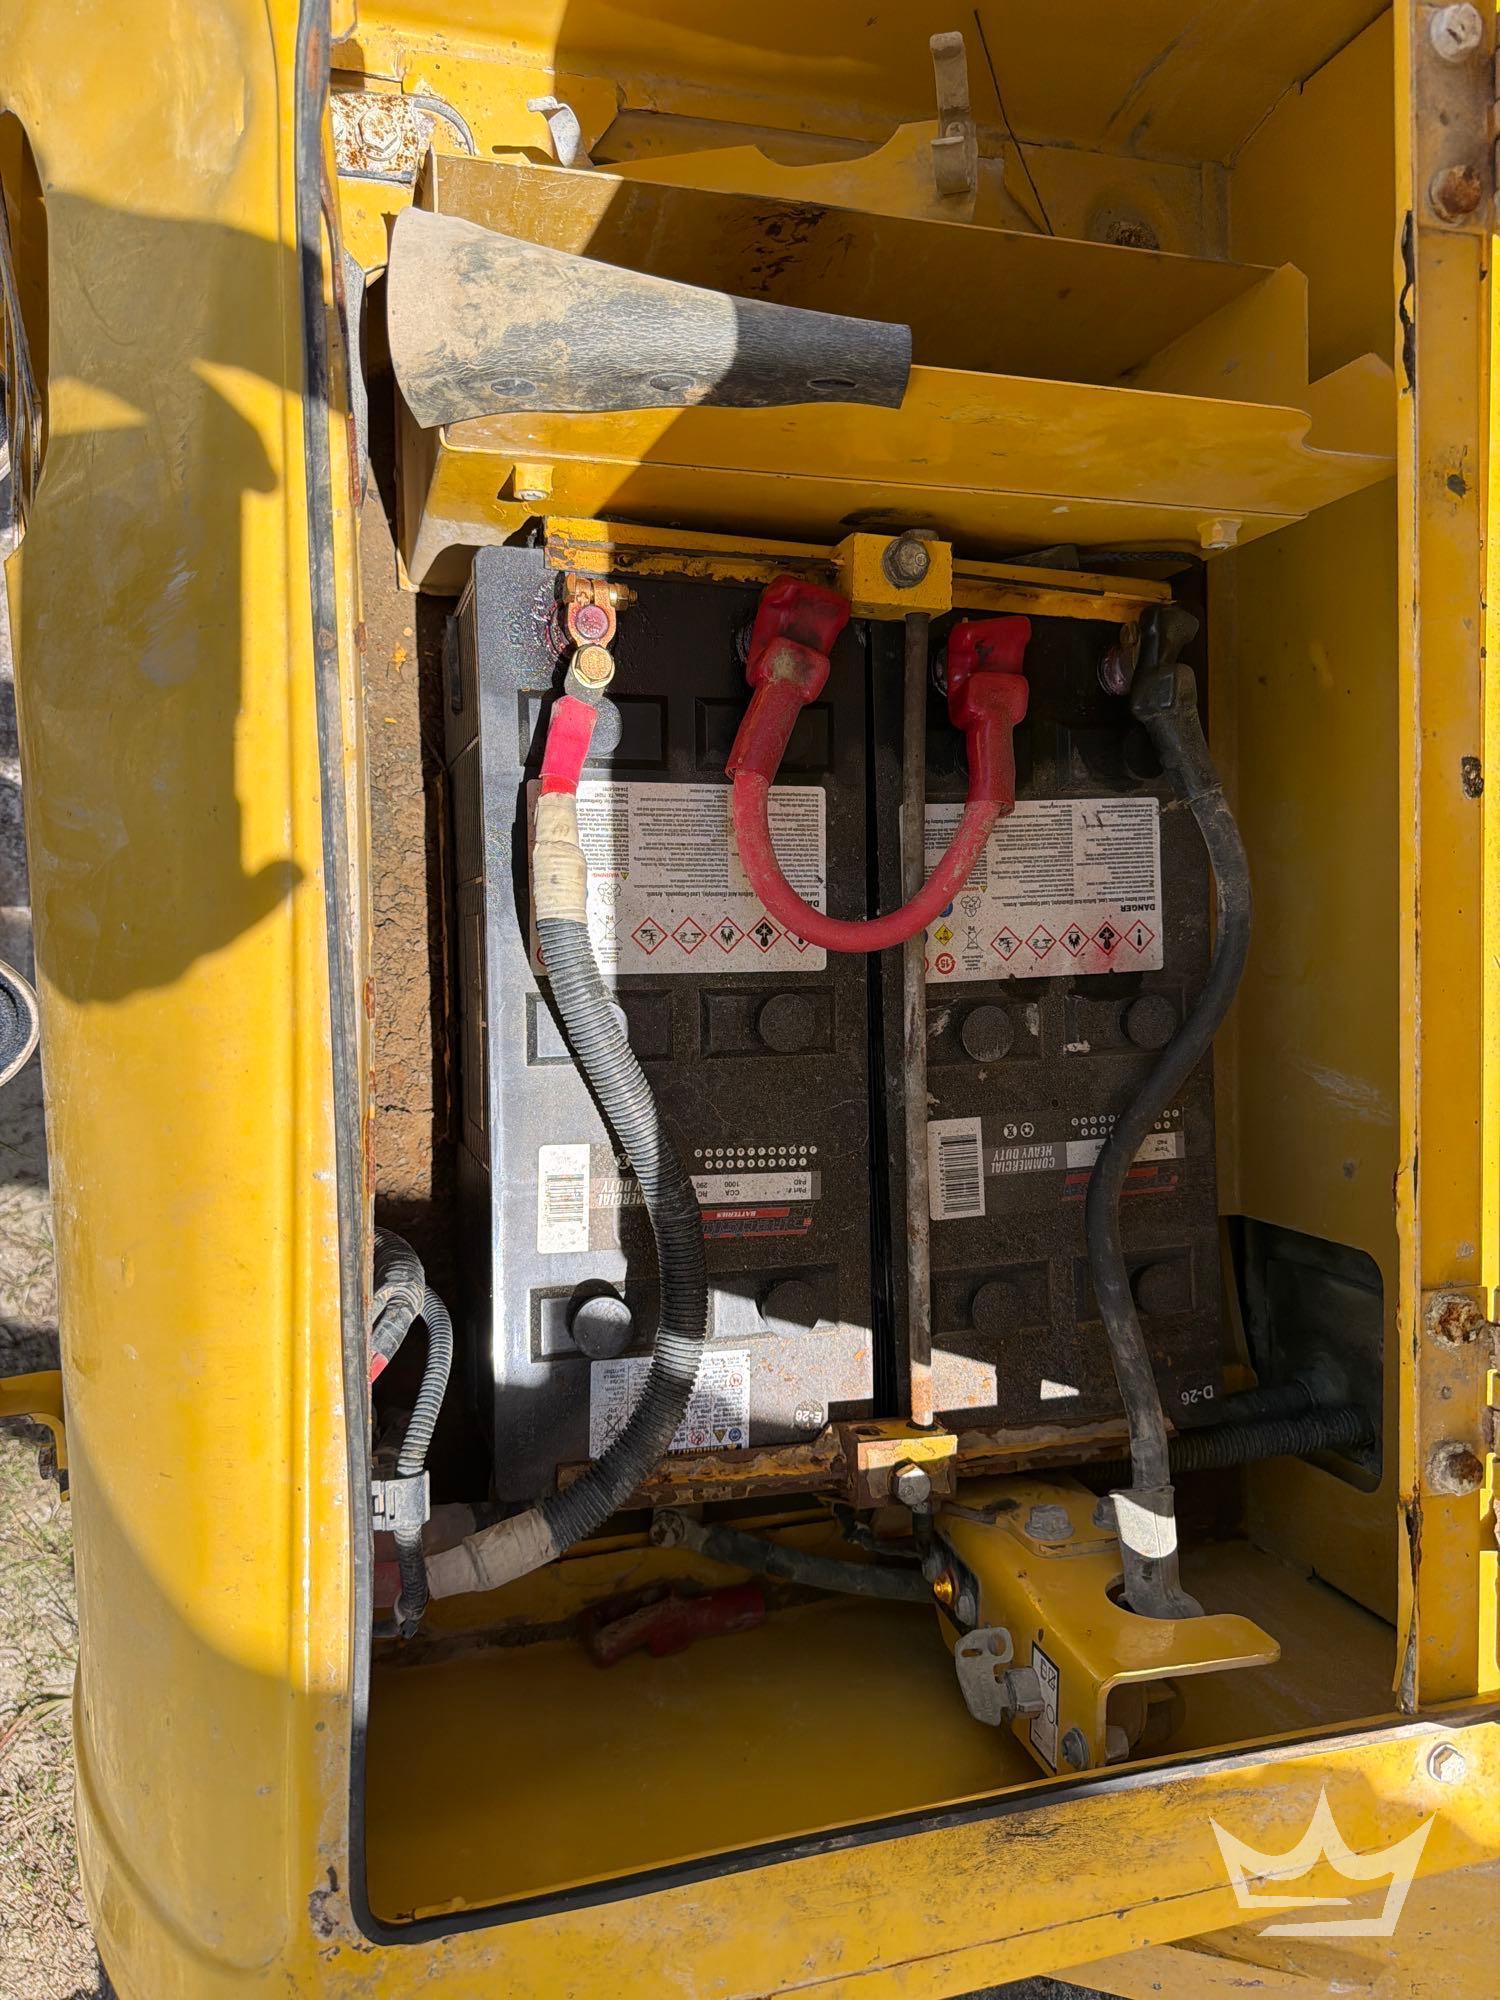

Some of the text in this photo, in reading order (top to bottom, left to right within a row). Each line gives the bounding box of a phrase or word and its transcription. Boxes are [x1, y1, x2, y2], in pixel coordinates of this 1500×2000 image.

[1120, 903, 1156, 912] DANGER
[992, 1145, 1053, 1161] HEAVY DUTY
[990, 1157, 1055, 1173] COMMERCIAL
[601, 1179, 632, 1192] DUTY
[1180, 1384, 1214, 1405] D-26
[795, 1409, 822, 1423] E-26
